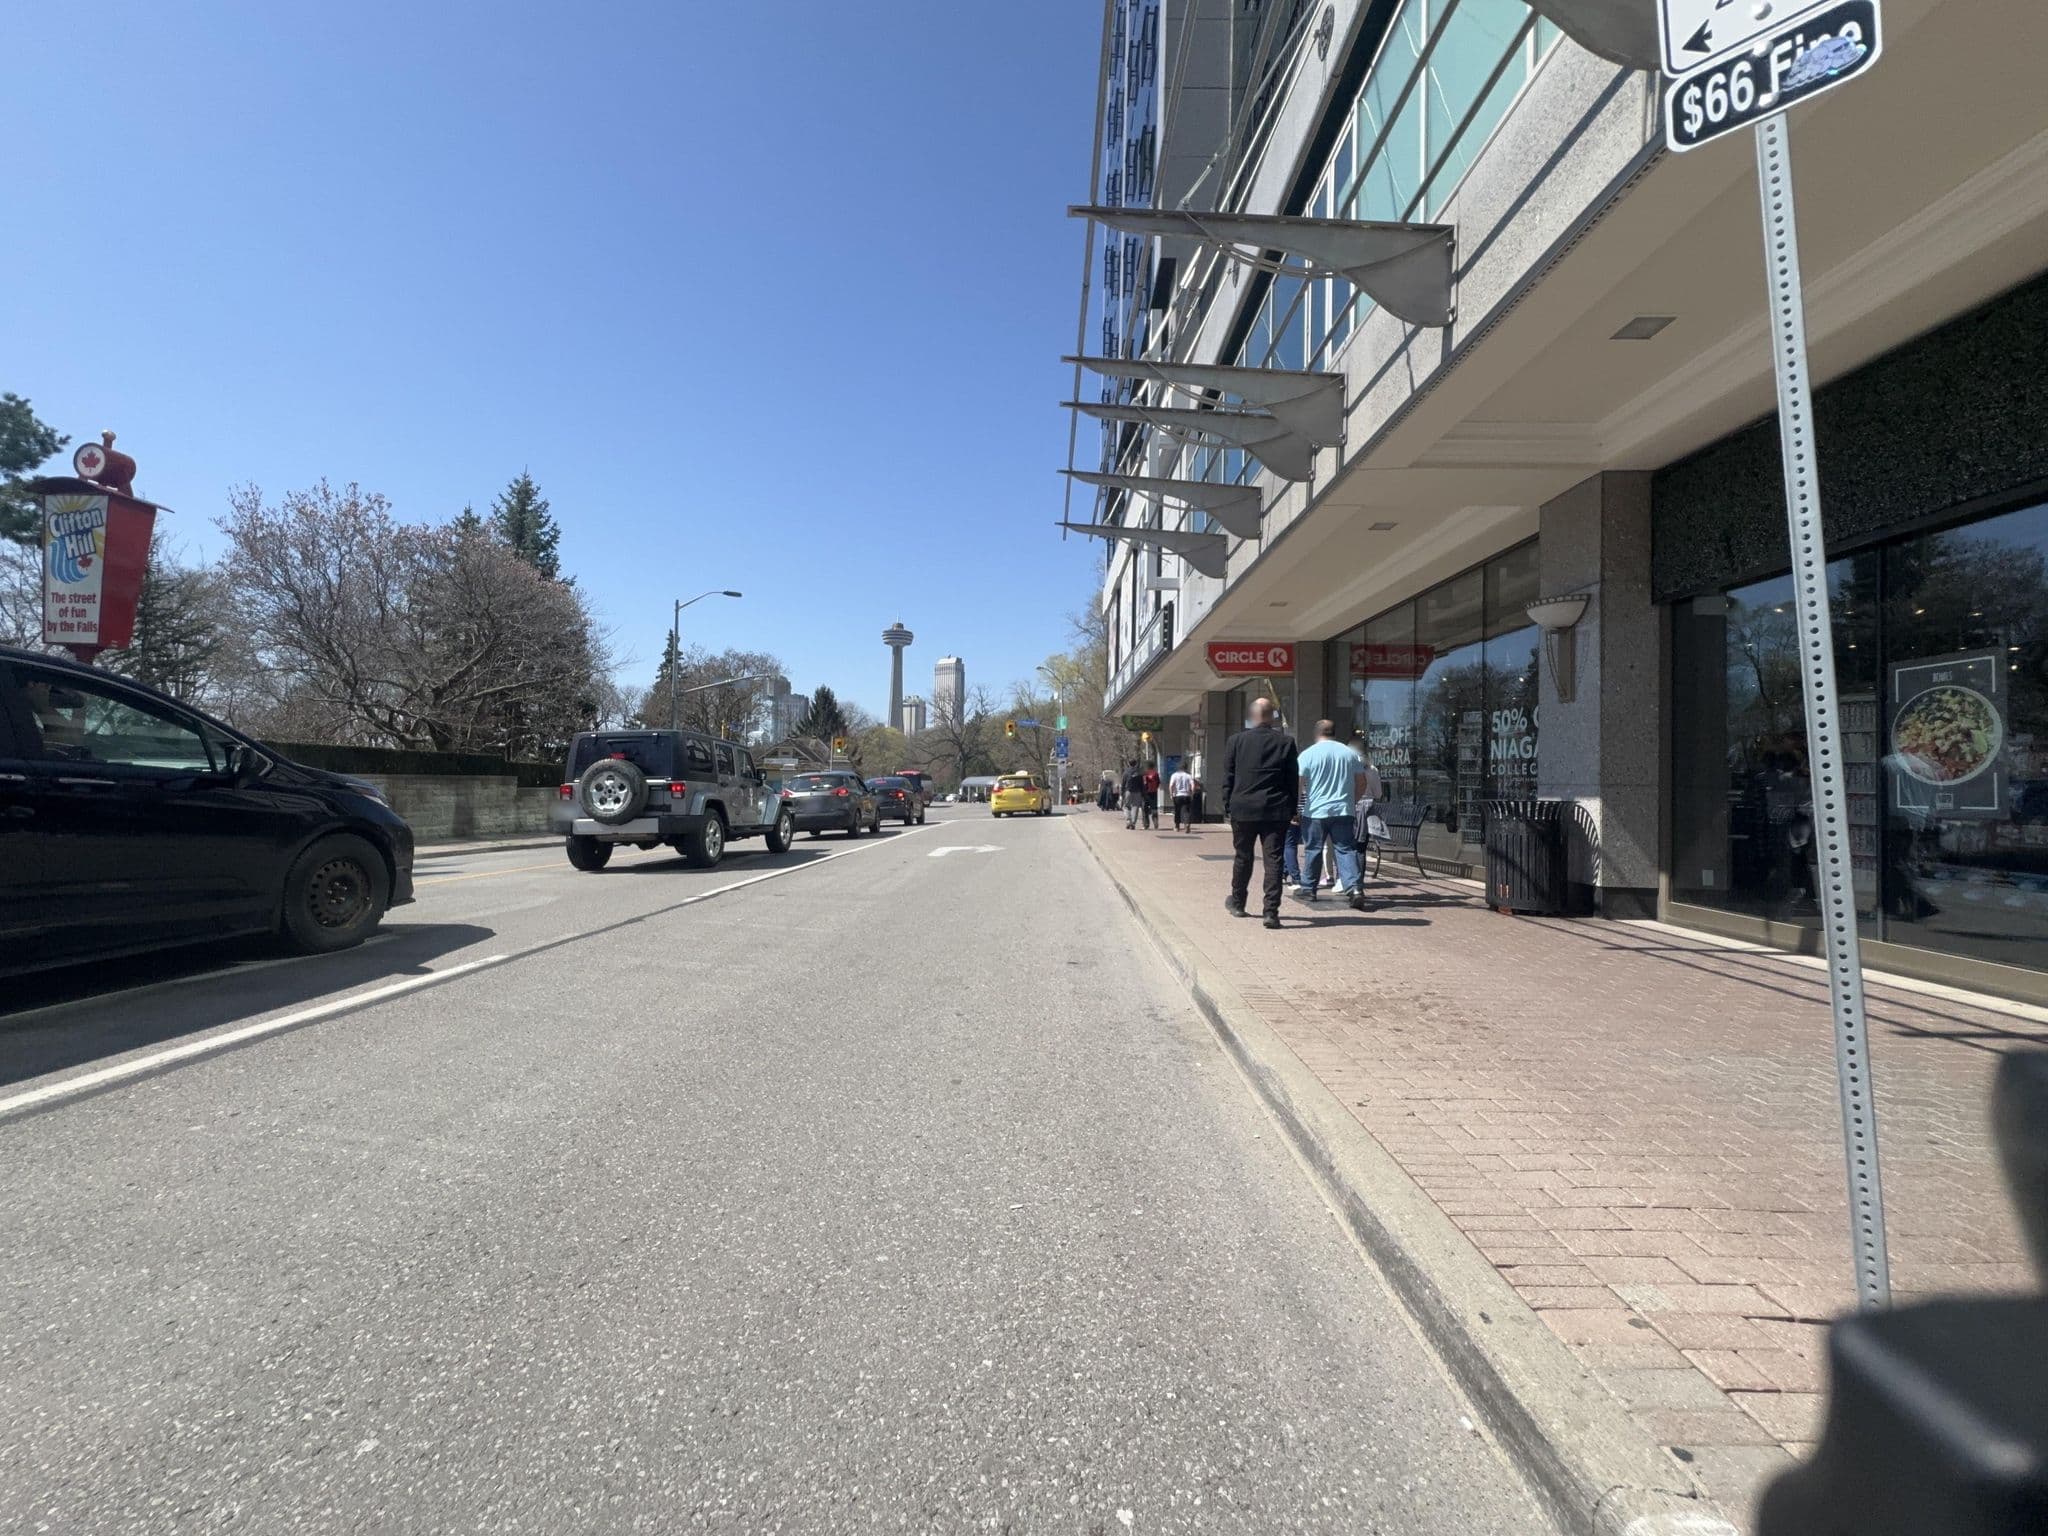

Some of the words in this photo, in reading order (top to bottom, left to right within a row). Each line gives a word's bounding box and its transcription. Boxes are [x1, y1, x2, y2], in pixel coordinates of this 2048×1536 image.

[1683, 60, 1754, 138] $66
[49, 509, 104, 537] Clifton
[64, 531, 96, 560] Hill
[51, 592, 66, 604] The
[69, 593, 97, 604] street
[59, 606, 69, 618] of
[71, 607, 87, 618] fun
[47, 620, 57, 634] by
[60, 621, 75, 632] the
[77, 621, 97, 633] Falls
[1215, 651, 1265, 664] CIRCLE
[1267, 647, 1288, 668] K
[1492, 706, 1528, 733] 50%
[1490, 736, 1539, 761] NIAG
[1490, 762, 1537, 775] COLLEC
